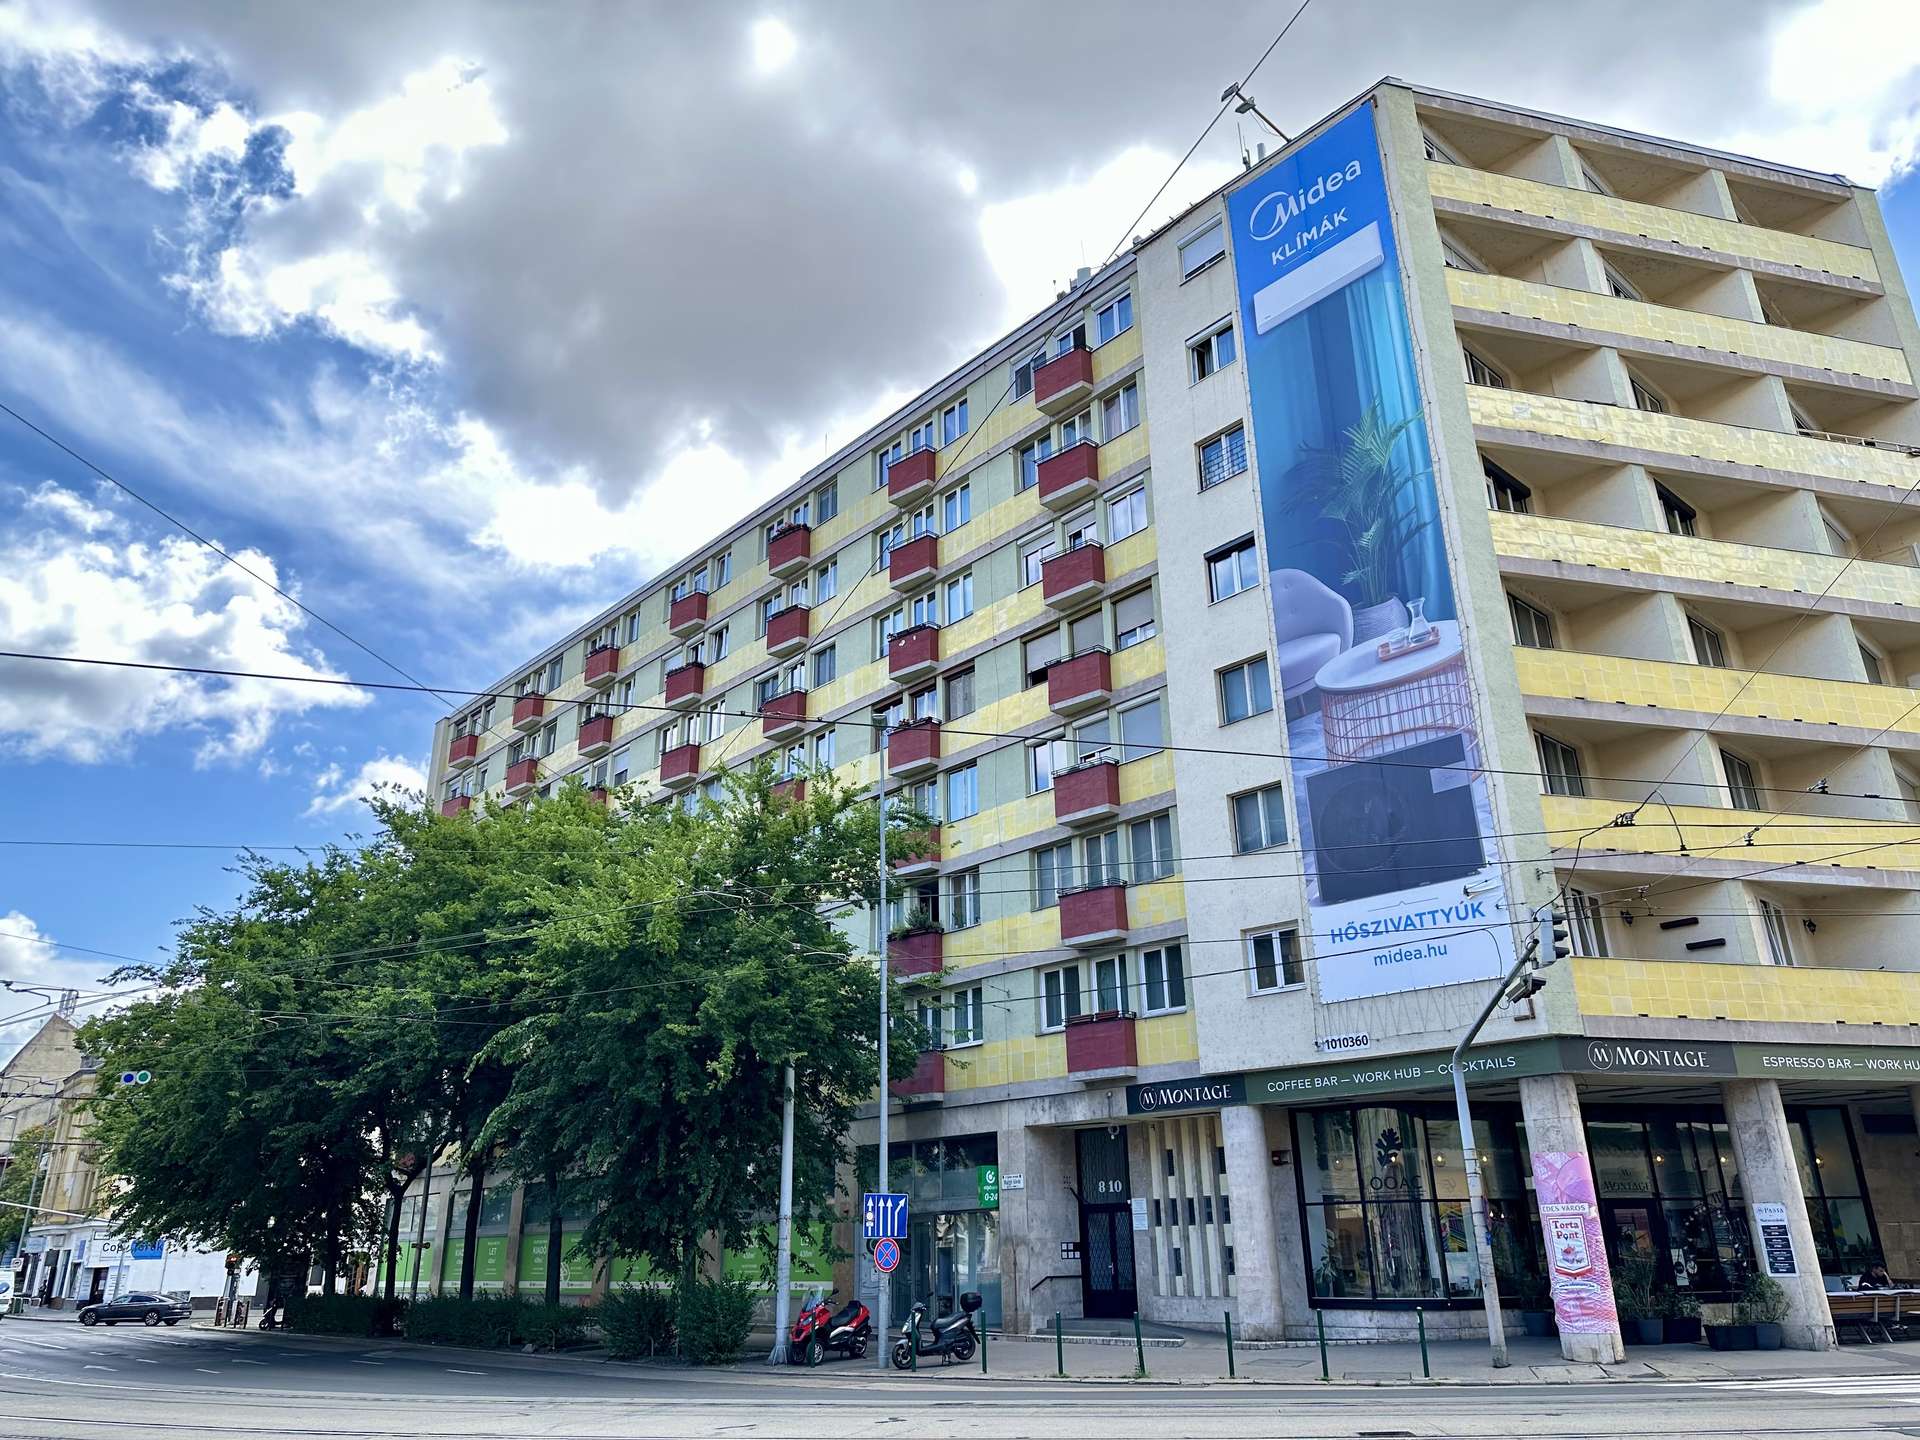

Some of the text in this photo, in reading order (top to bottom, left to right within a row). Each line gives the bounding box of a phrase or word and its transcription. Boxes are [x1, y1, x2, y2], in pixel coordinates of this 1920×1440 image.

[1249, 160, 1361, 241] Midea
[1271, 206, 1348, 266] KLÍMÁK
[1330, 900, 1486, 944] HŐSZIVATTYÚK
[1373, 943, 1448, 967] midea.hu
[1325, 1034, 1369, 1050] 1010360
[1615, 1046, 1710, 1068] MONTAGE
[1762, 1056, 1825, 1068] ESPRESSO
[1827, 1058, 1852, 1069] BAR
[1865, 1058, 1902, 1070] WORK
[1267, 1078, 1312, 1092] COFFEE
[1314, 1076, 1338, 1088] BAR
[1353, 1069, 1392, 1084] WORK
[1394, 1066, 1421, 1080] HUB
[1158, 1084, 1231, 1105] MONTAGE
[1552, 1221, 1579, 1230] Torta
